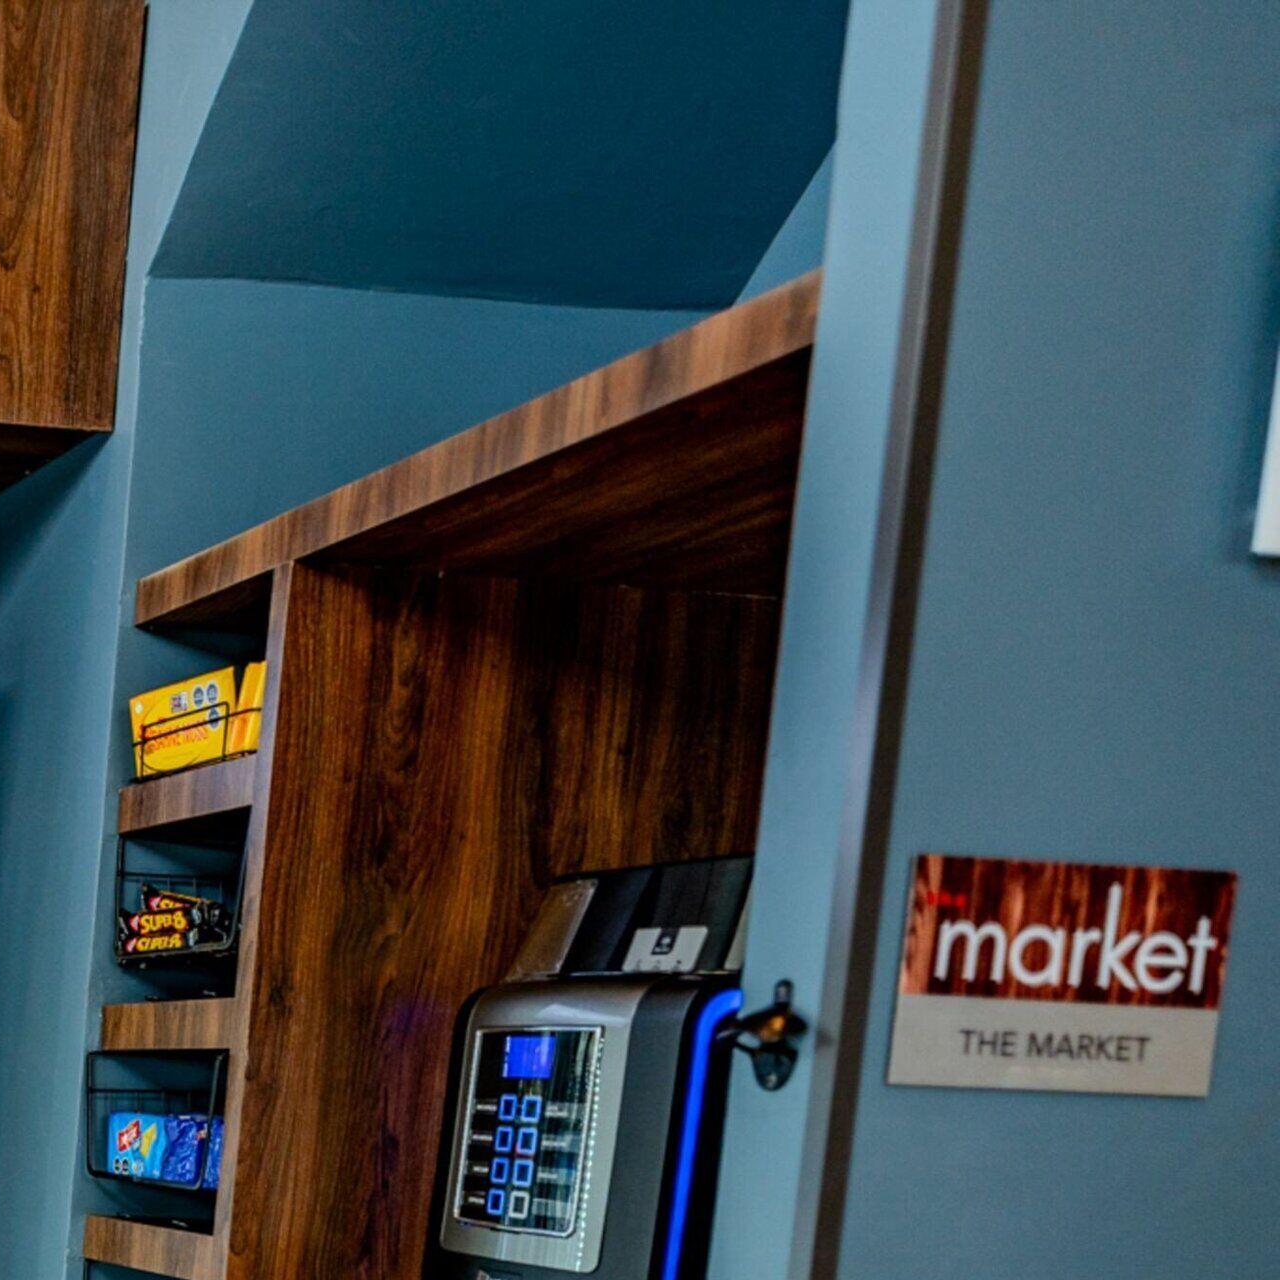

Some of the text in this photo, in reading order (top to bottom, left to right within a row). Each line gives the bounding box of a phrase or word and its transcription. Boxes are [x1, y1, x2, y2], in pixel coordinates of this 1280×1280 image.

[934, 881, 1218, 996] market
[960, 1029, 1151, 1062] THE MARKET
